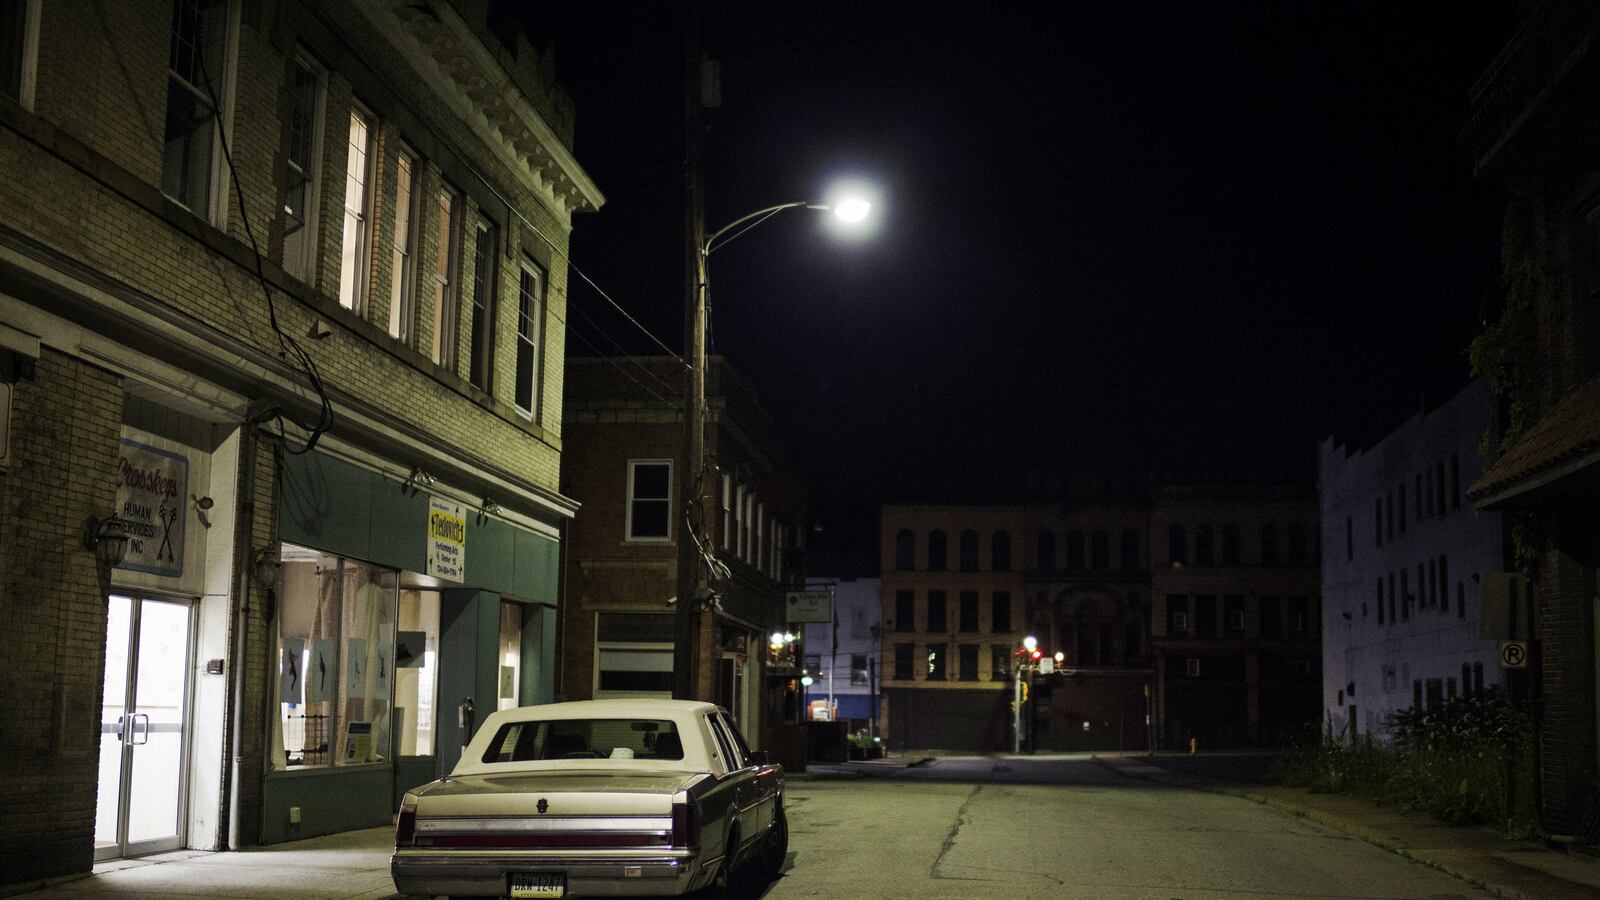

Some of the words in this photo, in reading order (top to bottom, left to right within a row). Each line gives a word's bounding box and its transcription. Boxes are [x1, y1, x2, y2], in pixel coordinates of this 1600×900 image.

[124, 501, 152, 520] HUMAN
[119, 520, 154, 538] ERVICES
[130, 538, 144, 554] INC
